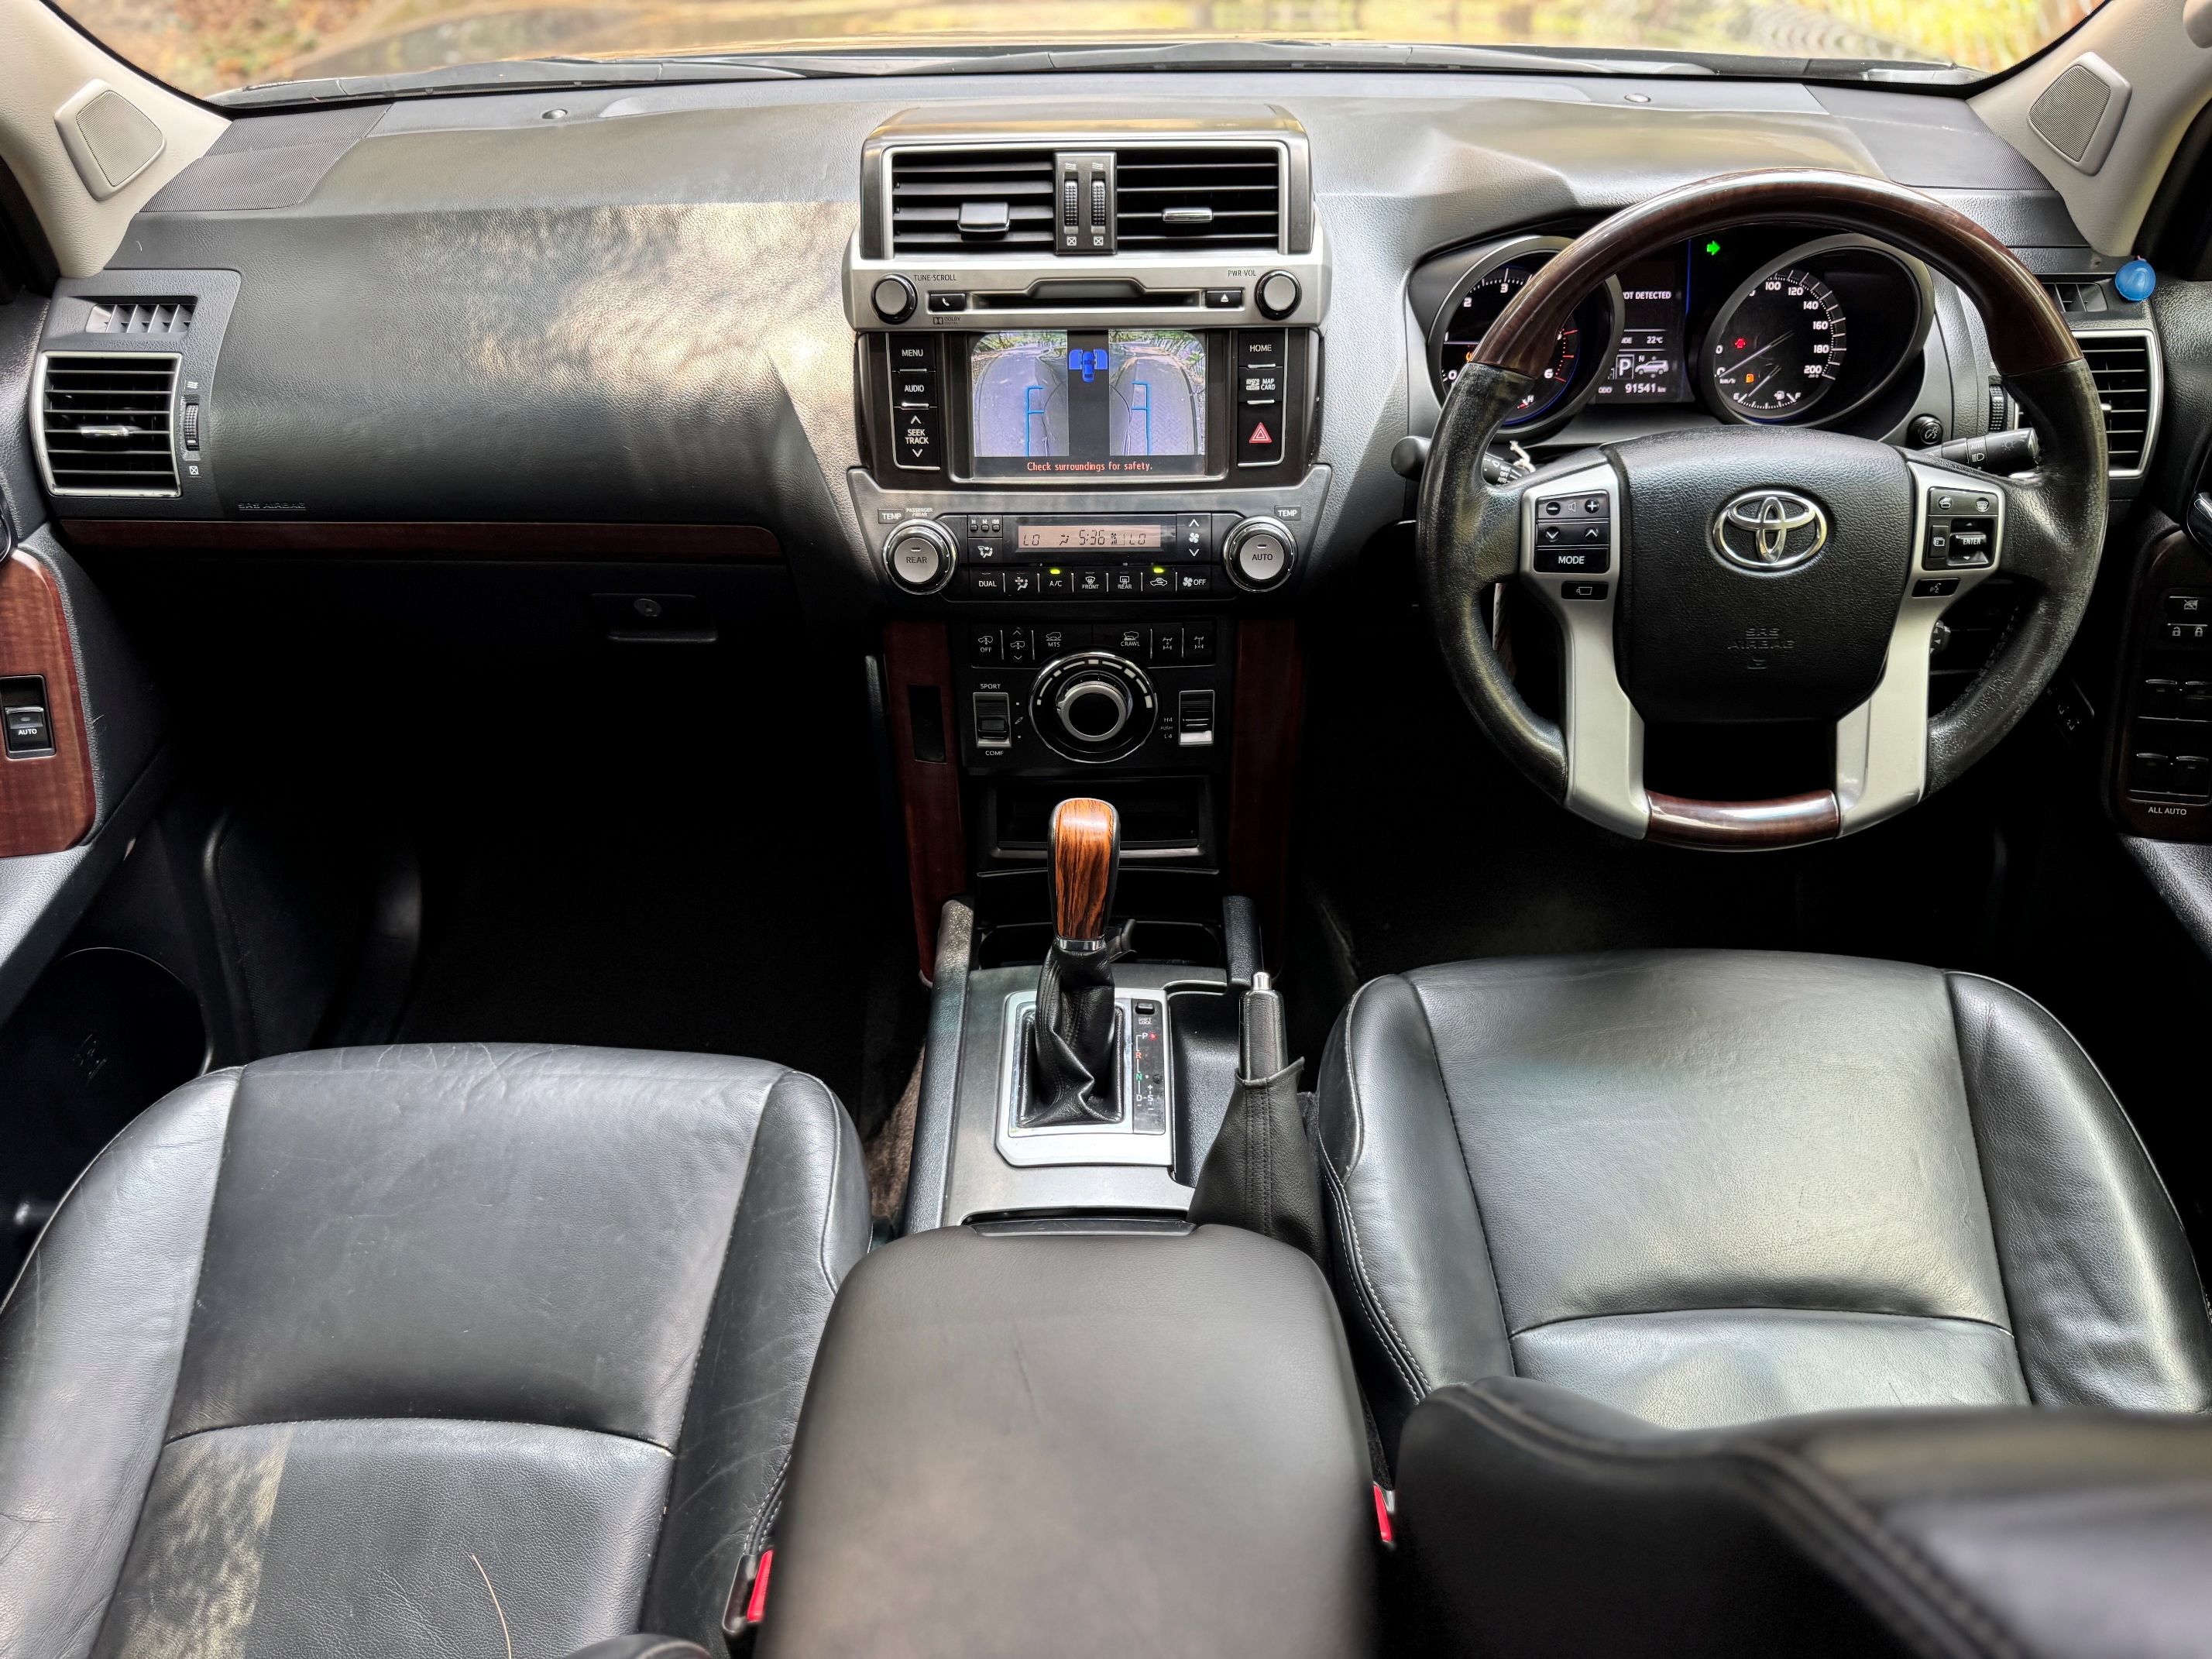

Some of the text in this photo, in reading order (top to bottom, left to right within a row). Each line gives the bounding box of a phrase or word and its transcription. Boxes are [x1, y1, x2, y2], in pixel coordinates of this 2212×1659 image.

[1500, 283, 1509, 294] 3
[1765, 281, 1781, 291] 100
[1635, 290, 1672, 300] DETECTED
[1788, 287, 1804, 296] 120
[1463, 297, 1472, 307] 2
[1803, 301, 1819, 310] 140
[1812, 321, 1829, 330] 160
[1249, 344, 1273, 352] HOME
[1813, 344, 1829, 353] 180
[902, 349, 924, 357] MENU
[1619, 359, 1631, 376] P
[1804, 365, 1822, 374] 200
[1448, 370, 1458, 380] 0
[1544, 369, 1554, 379] 6
[904, 384, 925, 393] AUDIO
[1625, 383, 1656, 393] 91541
[905, 436, 929, 445] TRACK
[1027, 461, 1153, 472] Check surroundings for safety.
[1277, 509, 1297, 517] TEMP
[1079, 529, 1105, 546] 5:36
[1558, 555, 1585, 565] MODE
[2164, 807, 2187, 816] AUTO
[1135, 1073, 1142, 1081] N
